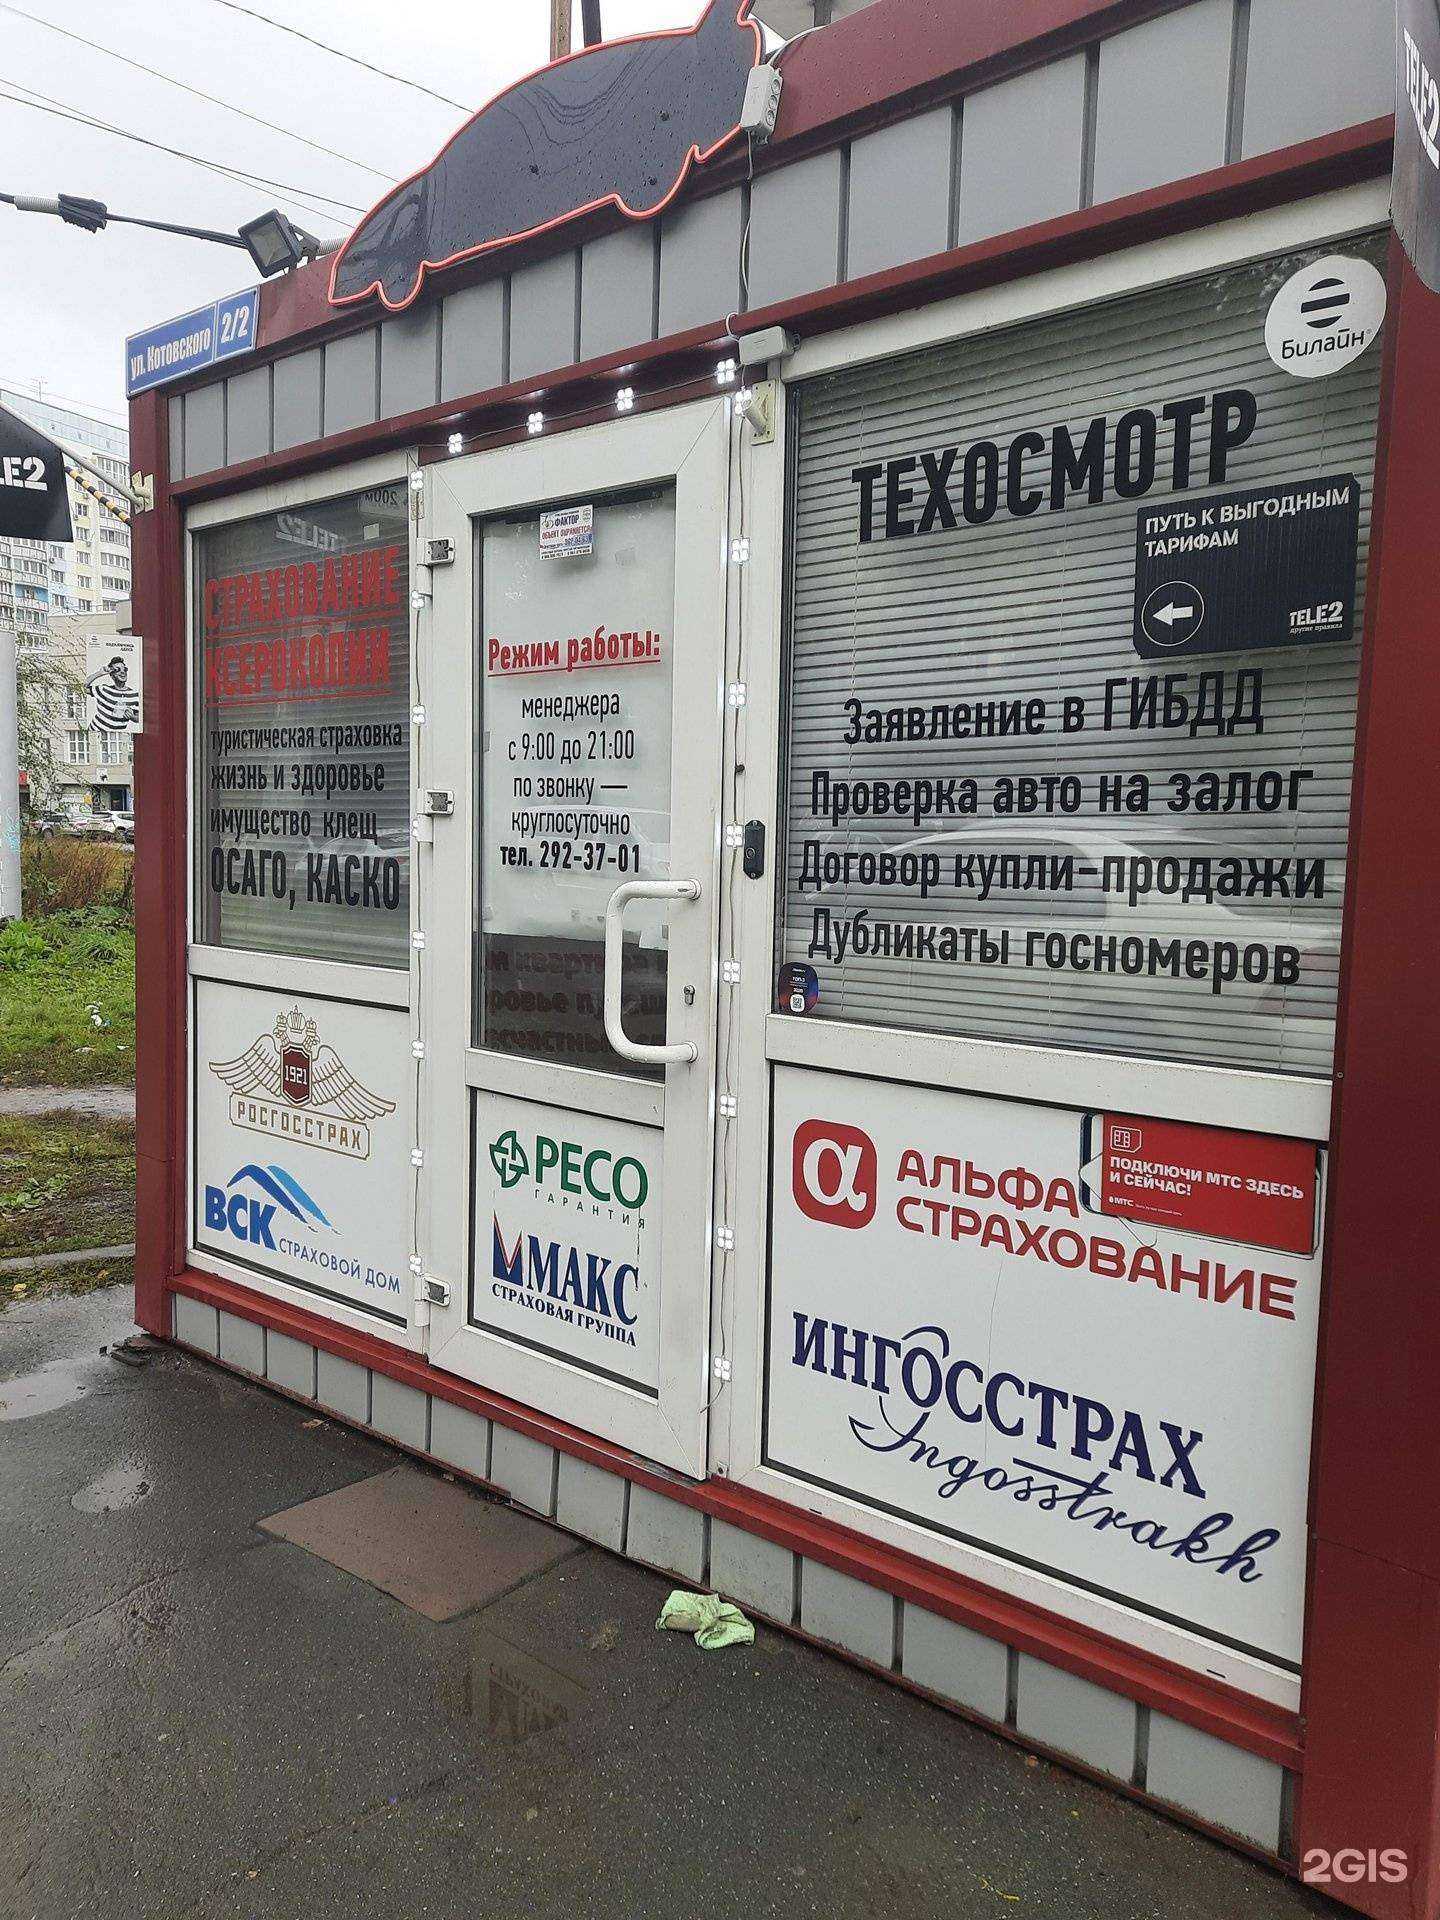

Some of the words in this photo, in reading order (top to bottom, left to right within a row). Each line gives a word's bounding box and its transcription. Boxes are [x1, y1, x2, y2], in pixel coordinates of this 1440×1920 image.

[130, 354, 146, 381] ул.
[147, 328, 211, 373] Котовского
[220, 305, 250, 343] 2/2
[1281, 329, 1365, 359] Билайн
[851, 388, 1257, 542] ТЕХОСМОТР
[1145, 512, 1197, 535] ПУТЬ
[1201, 508, 1215, 525] К
[1219, 486, 1350, 523] ВЫГОДНЫМ
[1144, 528, 1239, 558] ТАРИФАМ
[204, 545, 400, 629] СТРАХОВАНИЕ
[1290, 601, 1343, 626] TELE2
[204, 626, 390, 697] КСЕРОКОПИИ
[488, 638, 560, 671] Режим
[567, 625, 660, 673] работы:
[522, 693, 620, 722] менеджера
[843, 697, 1047, 745] Заявление
[1062, 696, 1085, 733] в
[1104, 668, 1264, 737] ГИБДД
[210, 726, 315, 756] туристическая
[319, 723, 403, 754] страховка
[508, 741, 517, 760] с
[521, 732, 555, 761] 9:00
[560, 739, 582, 764] до
[587, 730, 635, 760] 21:00
[211, 764, 268, 790] жизнь
[273, 764, 284, 790] и
[291, 763, 385, 800] здоровье
[513, 777, 532, 798] по
[536, 777, 595, 805] звонку
[811, 770, 979, 826] Проверка
[993, 770, 1082, 814] авто
[1099, 769, 1151, 812] на
[1168, 768, 1314, 812] залог
[210, 808, 311, 842] имущество
[323, 811, 378, 845] клещ
[511, 811, 631, 840] круглосуточно
[211, 846, 297, 910] ОСАГО,
[306, 852, 401, 911] КАСКО
[500, 845, 533, 867] тел.
[540, 840, 640, 873] 292-37-01
[799, 839, 940, 899] Договор
[955, 851, 1326, 907] купли-продажи
[808, 907, 1009, 965] Дубликаты
[1025, 930, 1301, 994] госномеров
[284, 1065, 308, 1085] 1921
[237, 1101, 362, 1150] РОСГОССТРАХ
[535, 1134, 649, 1210] РЕСО
[896, 1149, 1080, 1218] АЛЬФА
[1109, 1171, 1121, 1184] И
[1124, 1173, 1191, 1196] СЕЙЧАС!
[1110, 1156, 1202, 1182] ПОДКЛЮЧИ
[1206, 1172, 1242, 1189] МТС
[1246, 1178, 1304, 1199] ЗДЕСЬ
[204, 1183, 278, 1251] ВСК
[534, 1188, 645, 1229] ГАРАНТИЯ
[279, 1237, 362, 1280] СТРАХОВОЙ
[365, 1267, 401, 1294] ДОМ
[527, 1234, 639, 1326] МАКС
[896, 1195, 1298, 1321] СТРАХОВАНИЕ
[491, 1282, 574, 1324] СТРАХОВАЯ
[577, 1312, 637, 1347] ГРУППА
[791, 1310, 1207, 1500] ИНГОССТРАХ
[848, 1411, 1281, 1583] Ingosstrakh
